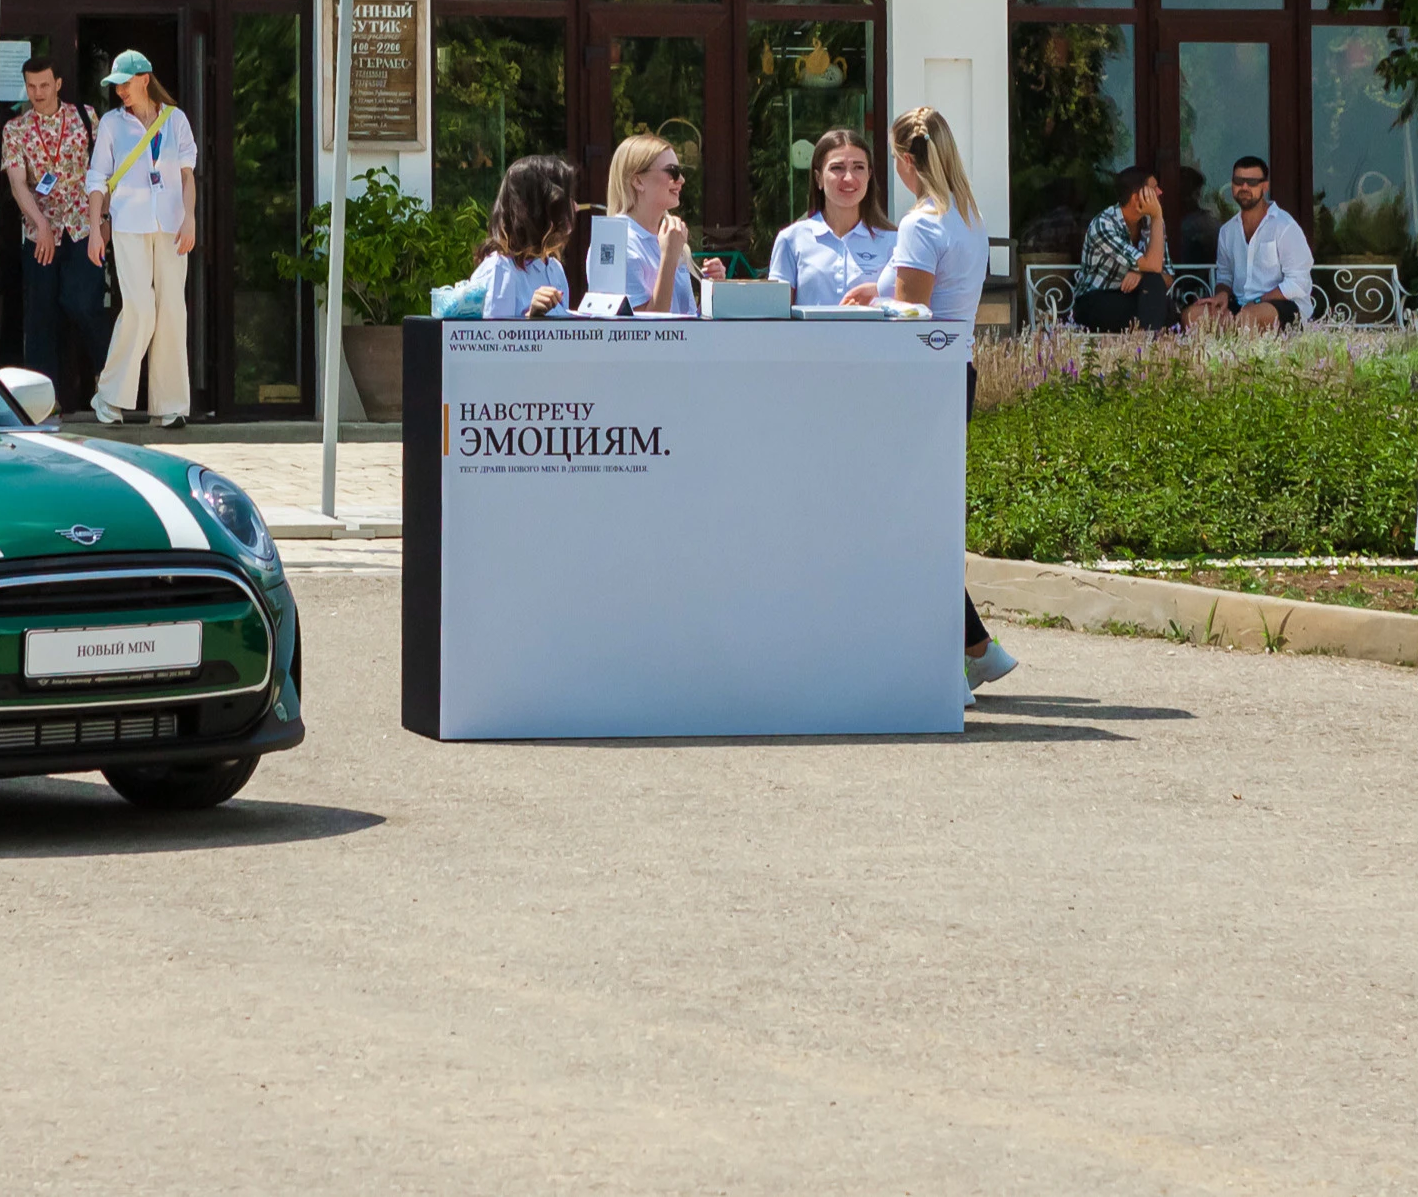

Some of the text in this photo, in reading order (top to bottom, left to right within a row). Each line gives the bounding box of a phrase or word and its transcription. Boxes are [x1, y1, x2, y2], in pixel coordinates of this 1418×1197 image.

[337, 2, 413, 18] ИННЫЙ
[450, 328, 688, 342] АТЛАС. ОФИЦИАЛЬНЫЙ ДИЛЕР MINI.
[449, 343, 543, 352] WWW.MINI-ATLAS.RU
[459, 403, 595, 422] НАВСТРЕЧУ
[459, 426, 671, 462] ЭМОЦИЯМ.
[541, 465, 560, 473] MINI
[77, 640, 156, 657] НОВЫЙ MINI
